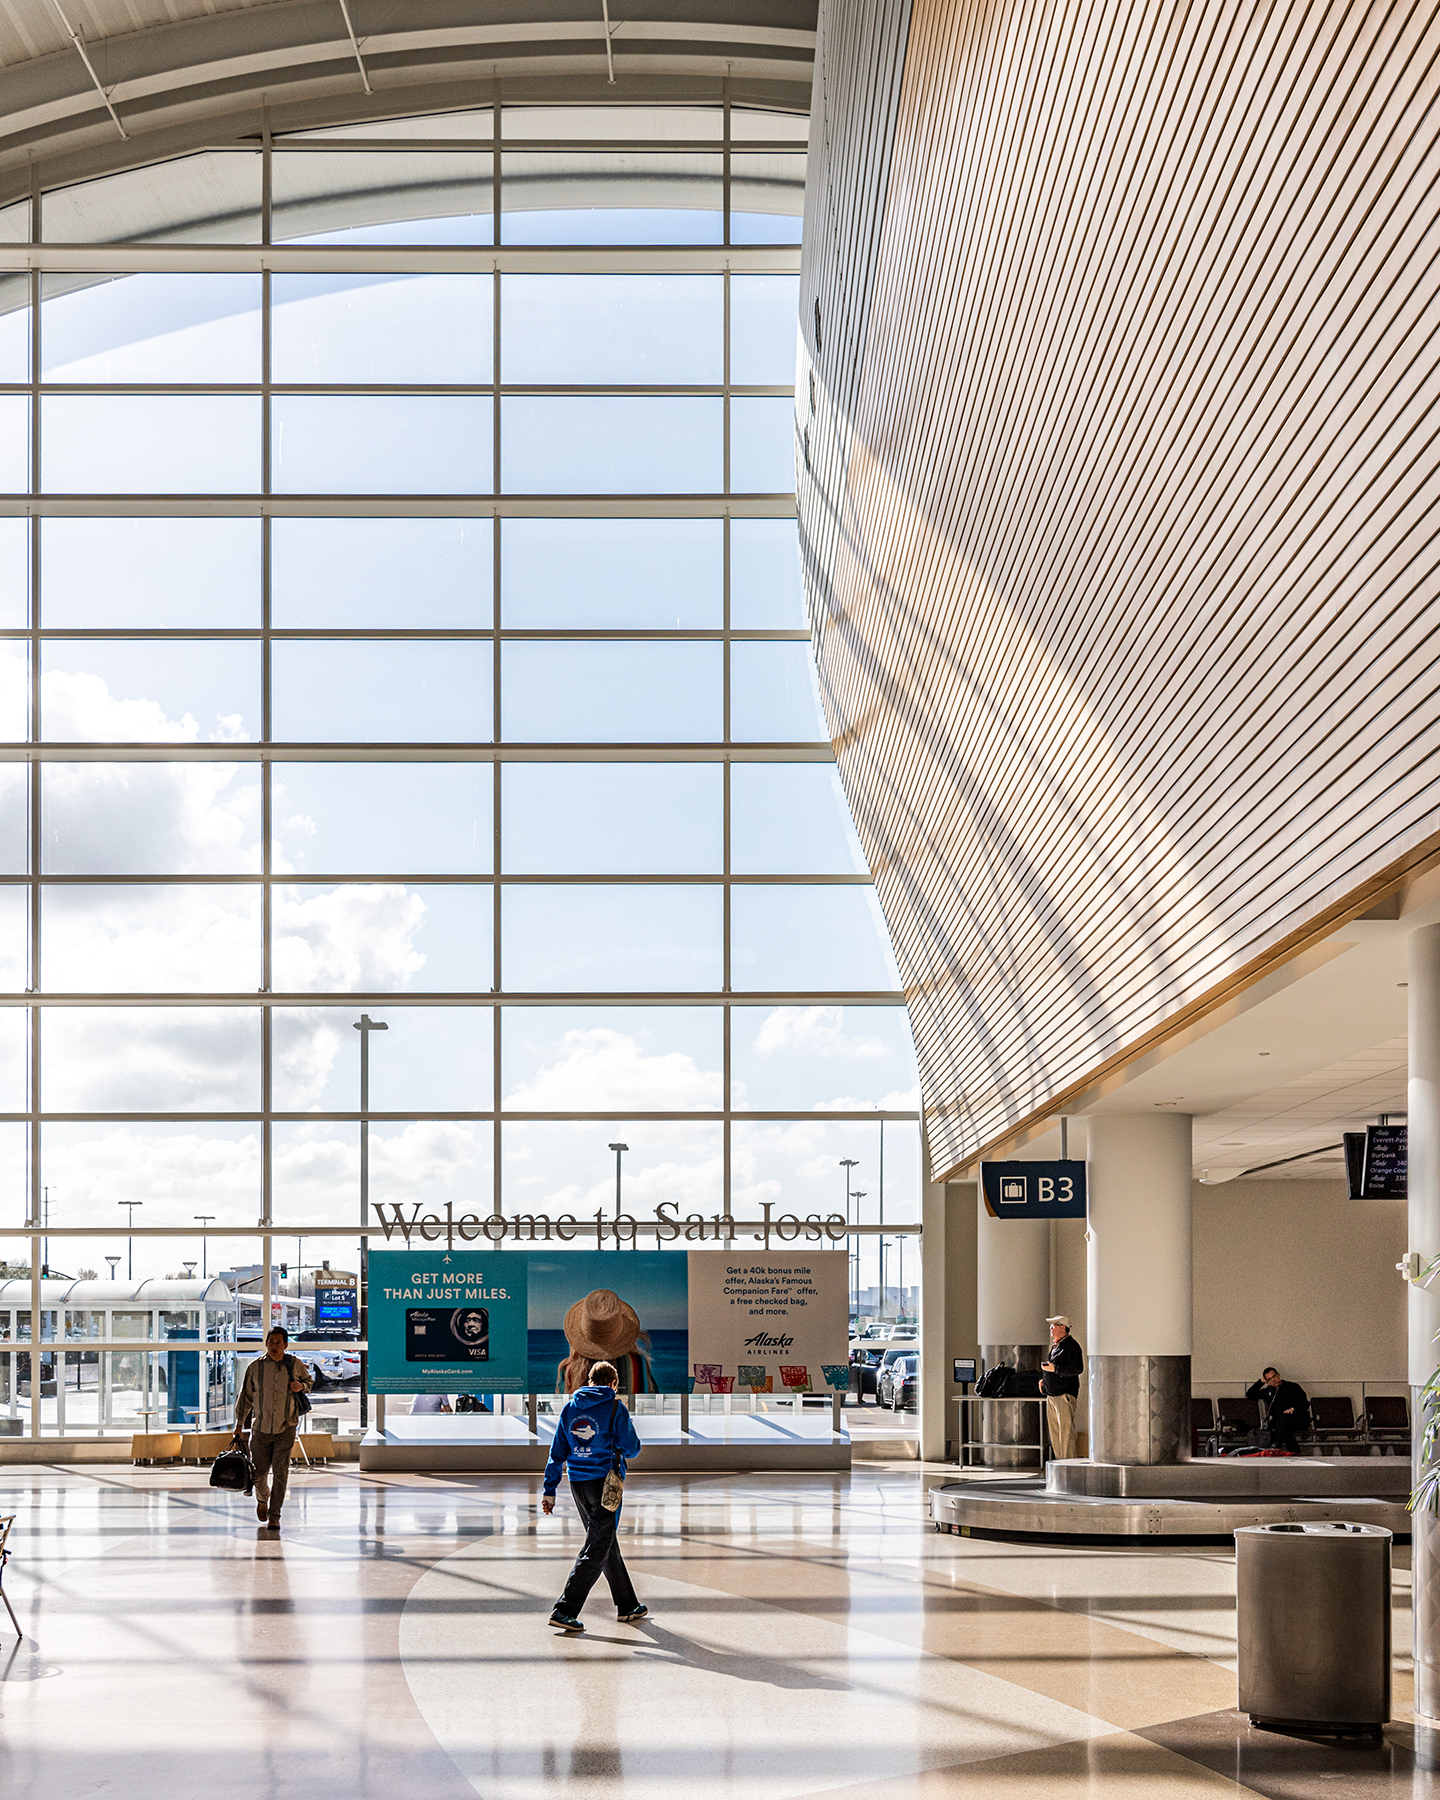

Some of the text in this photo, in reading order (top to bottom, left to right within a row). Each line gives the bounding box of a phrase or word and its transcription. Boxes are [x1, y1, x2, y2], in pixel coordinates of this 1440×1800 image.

[1038, 1176, 1074, 1202] B3
[370, 1200, 846, 1242] Welcome to San Jose
[411, 1273, 483, 1284] GET MORE
[725, 1277, 746, 1285] offer,
[383, 1288, 511, 1299] THAN JUST MILES.
[723, 1287, 769, 1295] Companion
[797, 1287, 818, 1295] offer,
[790, 1298, 807, 1306] bag,
[744, 1332, 794, 1348] Alaska
